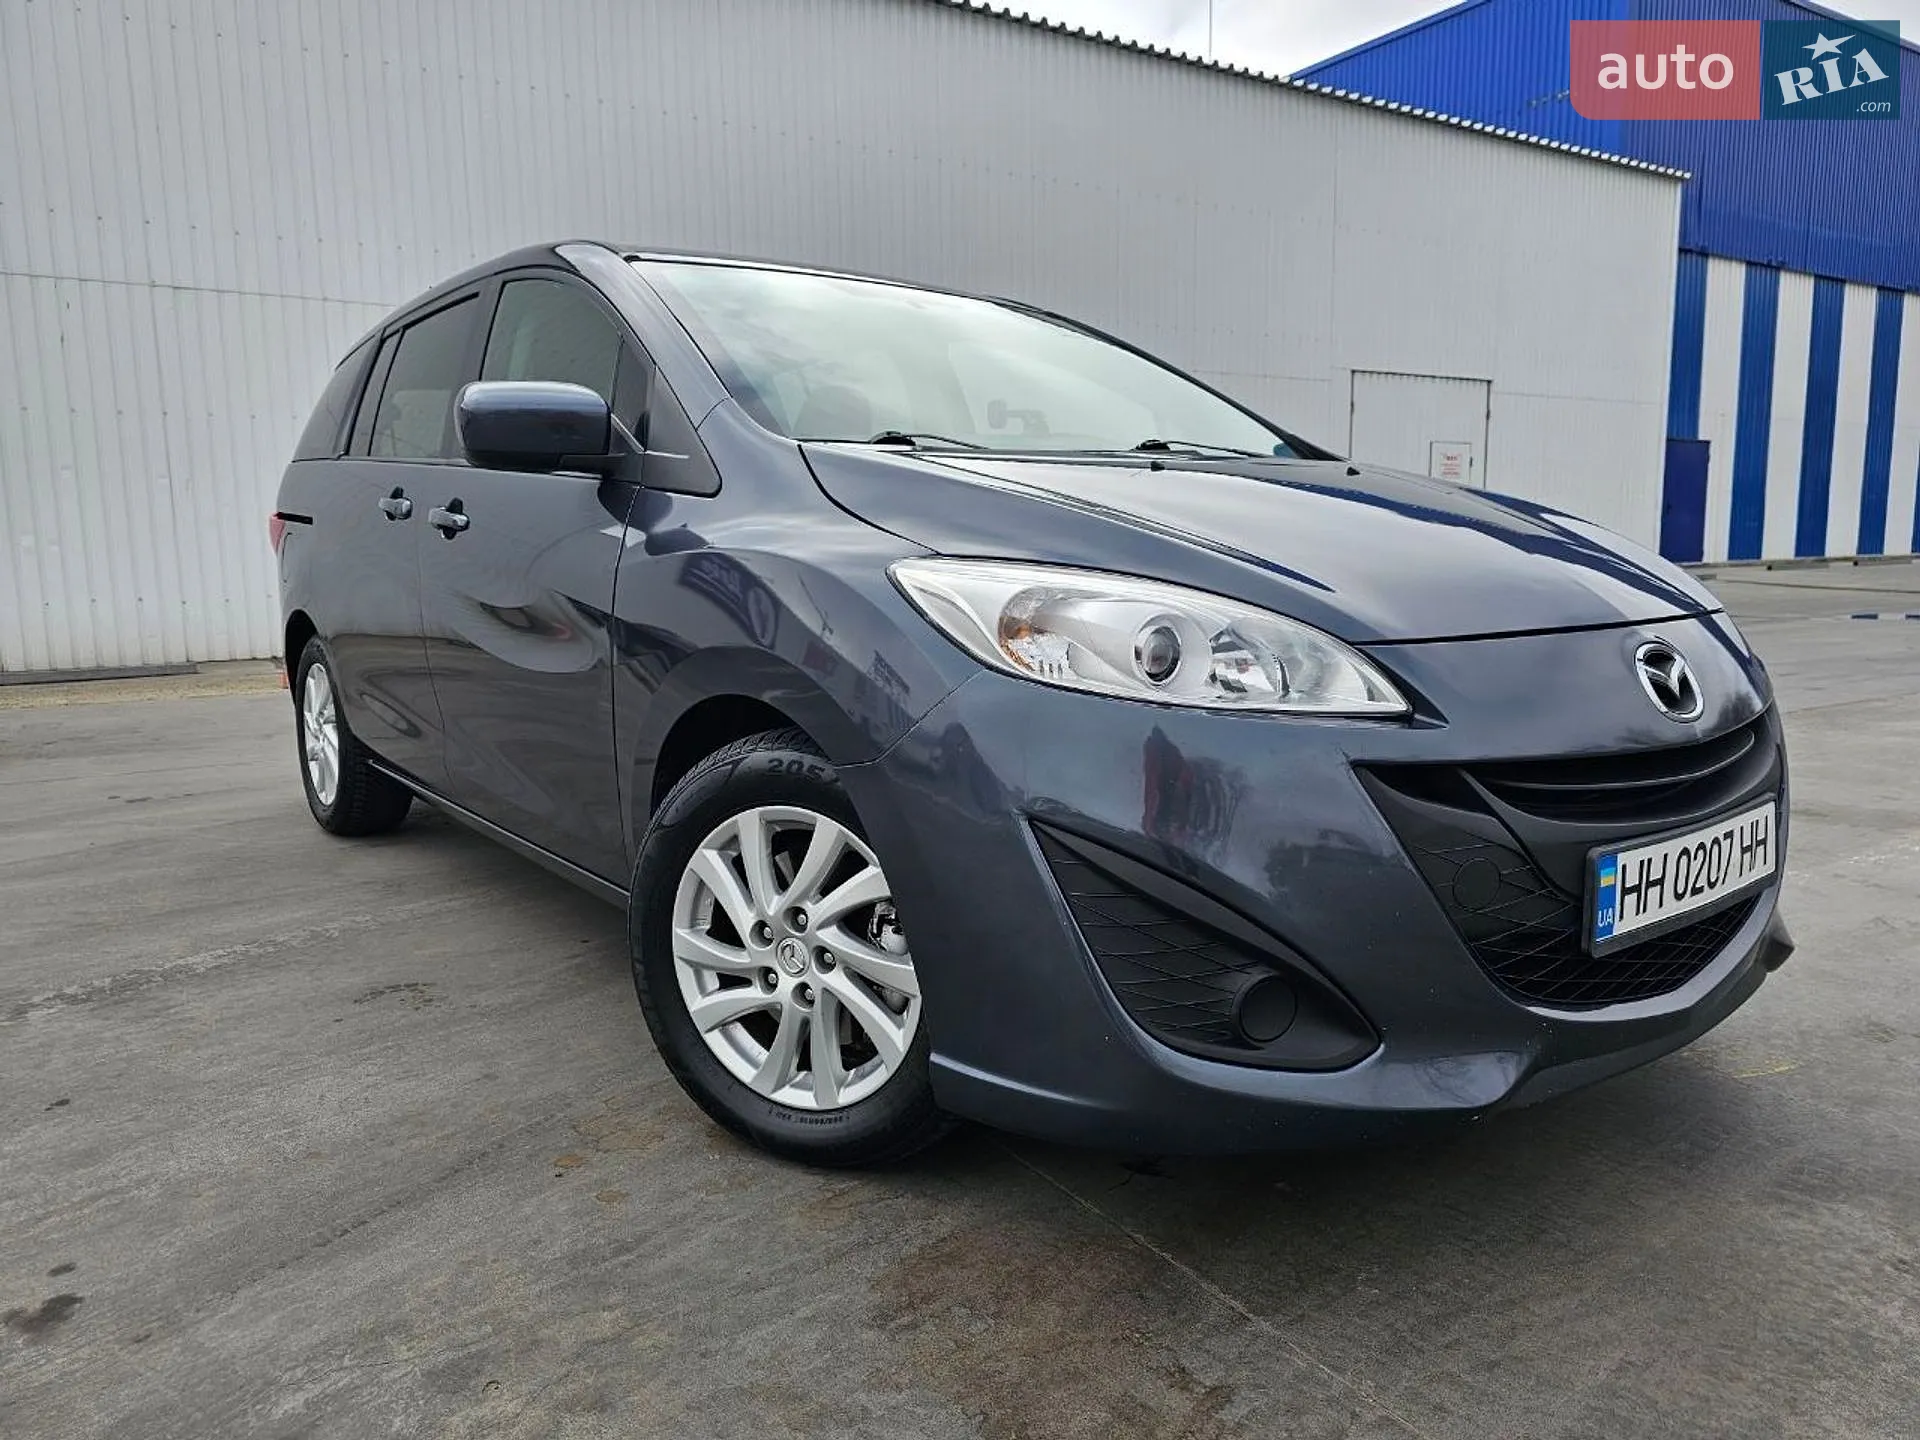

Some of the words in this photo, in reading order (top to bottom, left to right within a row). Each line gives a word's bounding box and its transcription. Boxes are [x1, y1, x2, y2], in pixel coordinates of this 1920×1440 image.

[1619, 853, 1668, 921] HH
[1673, 830, 1734, 901] 0207
[1739, 815, 1768, 877] HH
[1597, 908, 1613, 927] UA
